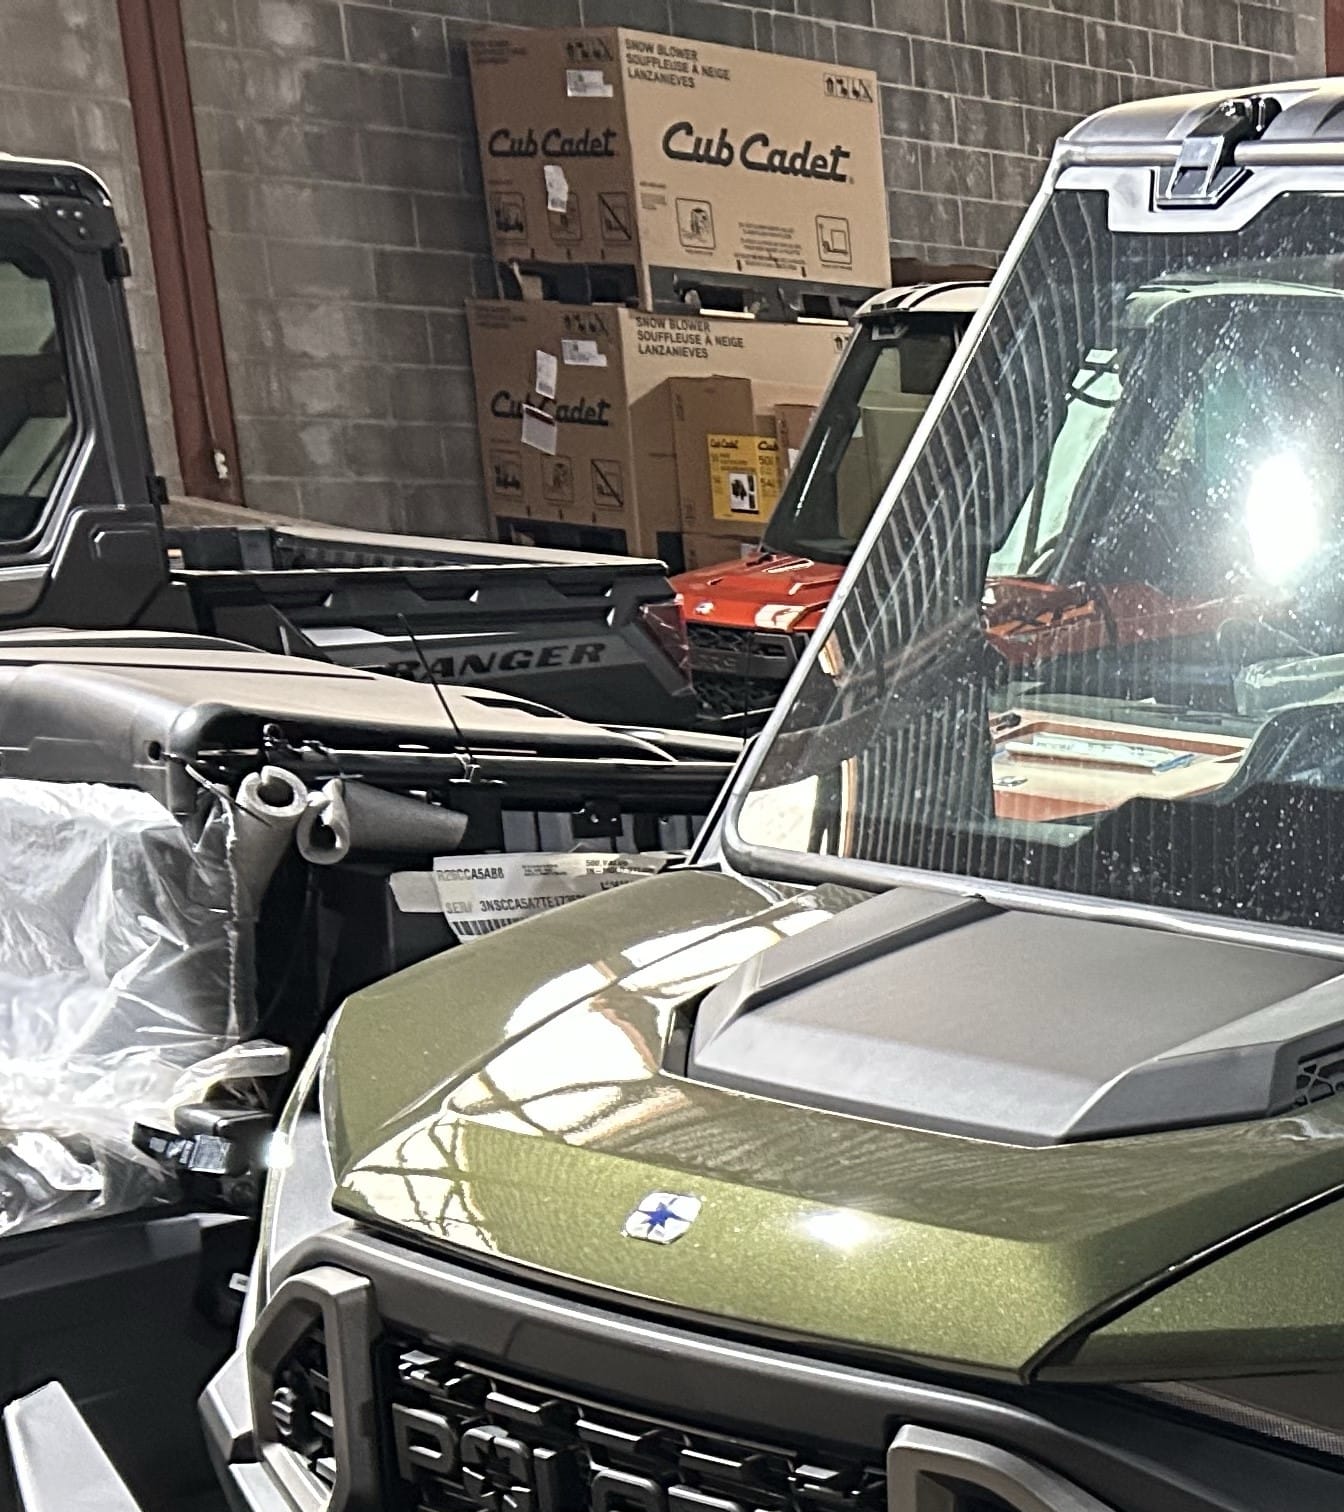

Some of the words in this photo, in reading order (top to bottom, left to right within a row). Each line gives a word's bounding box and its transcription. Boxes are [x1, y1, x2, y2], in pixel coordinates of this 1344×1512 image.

[625, 39, 655, 55] SNOW
[656, 44, 699, 62] BLOWER
[626, 53, 690, 75] SOUFFLEUSE
[702, 66, 731, 81] NEIGE
[627, 67, 696, 88] LANZANIEVES
[488, 128, 538, 158] Cub
[541, 128, 617, 157] Cadet
[662, 121, 734, 167] Cub
[739, 132, 851, 182] Cadet
[635, 316, 666, 330] SNOW
[668, 318, 711, 333] BLOWER
[637, 329, 702, 346] SOUFFLEUSE
[715, 335, 744, 348] NEIGE
[638, 346, 709, 359] LANZANIEVES
[386, 641, 607, 681] RANGER
